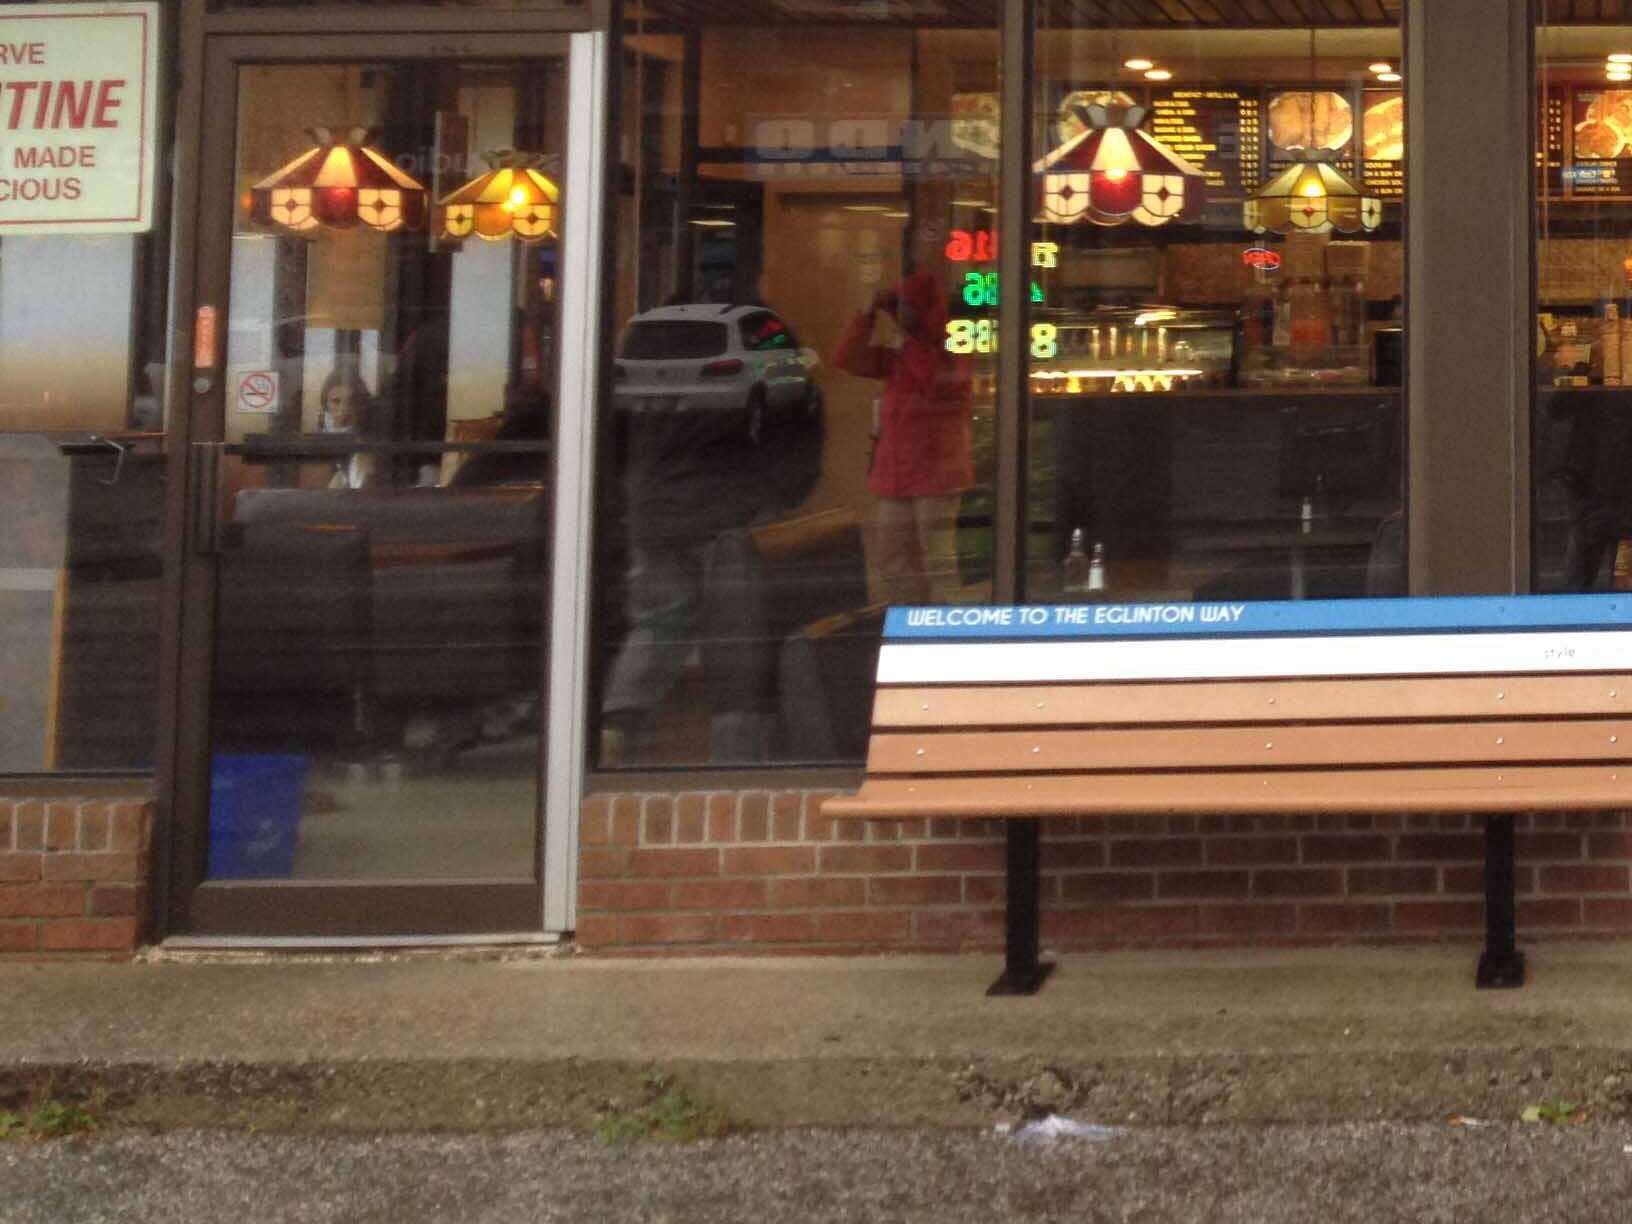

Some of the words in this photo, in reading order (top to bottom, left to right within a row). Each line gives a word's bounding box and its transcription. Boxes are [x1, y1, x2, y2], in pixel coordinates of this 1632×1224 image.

[0, 79, 126, 130] TINE
[14, 145, 97, 168] MADE
[907, 608, 1011, 626] WELCOME
[1019, 608, 1048, 625] TO
[1053, 607, 1087, 624] THE
[1094, 605, 1194, 623] EGLINTON
[1199, 604, 1246, 621] WAY
